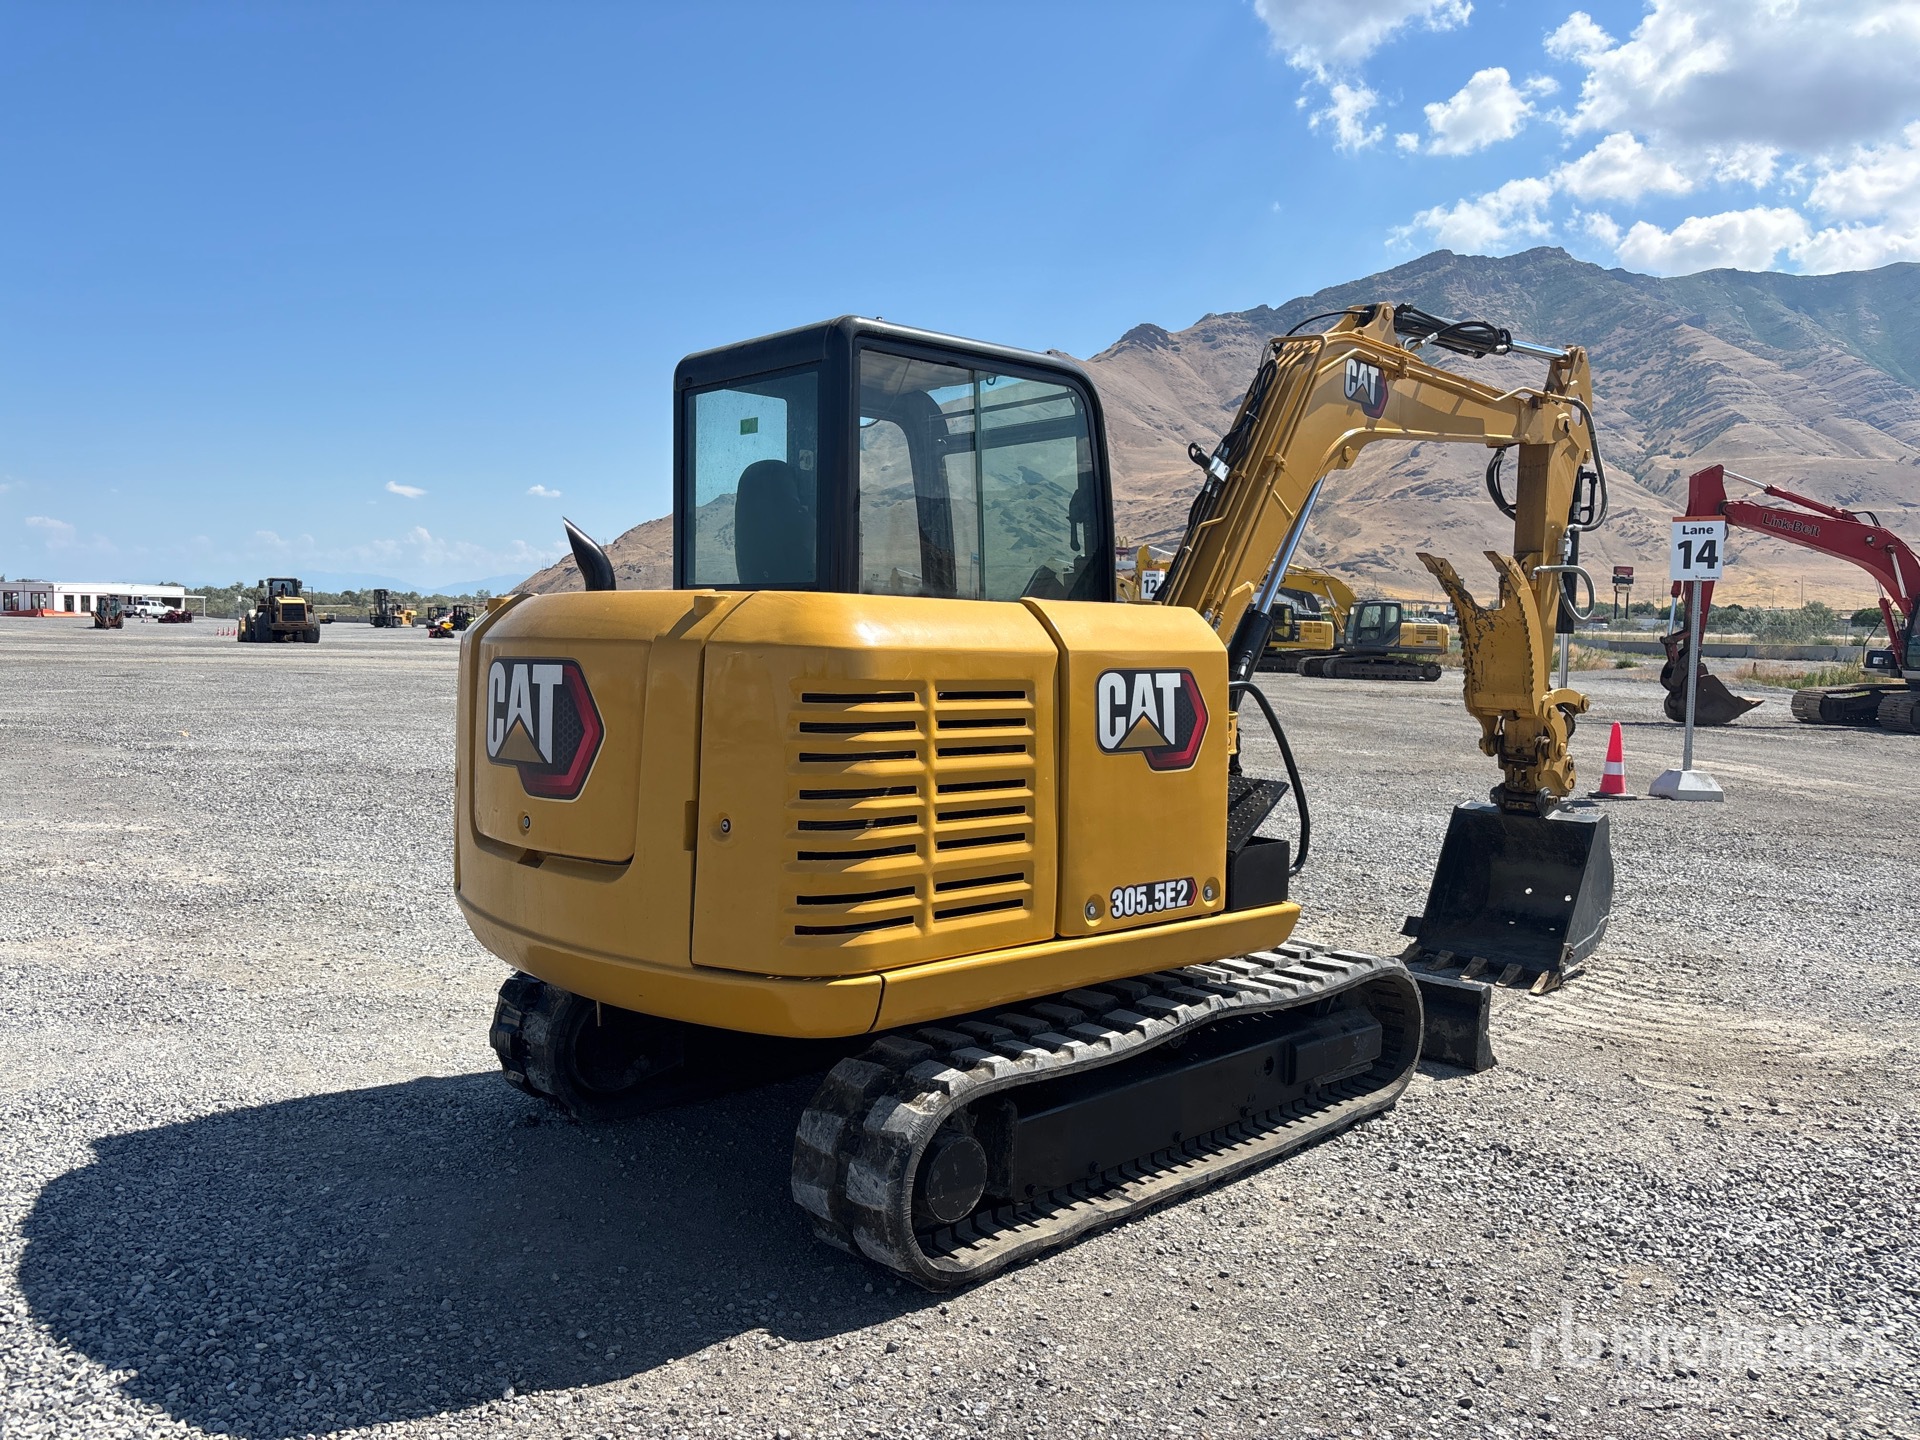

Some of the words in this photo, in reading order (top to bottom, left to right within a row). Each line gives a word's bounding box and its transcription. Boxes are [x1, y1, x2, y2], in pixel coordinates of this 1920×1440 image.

[1346, 358, 1379, 405] CAT
[1682, 525, 1714, 535] Lane
[1762, 513, 1820, 537] Link-Belt
[1677, 540, 1718, 569] 14
[1144, 580, 1157, 593] 12
[487, 661, 563, 764] CAT
[1098, 672, 1181, 749] CAT
[1111, 880, 1188, 918] 305.5E2
